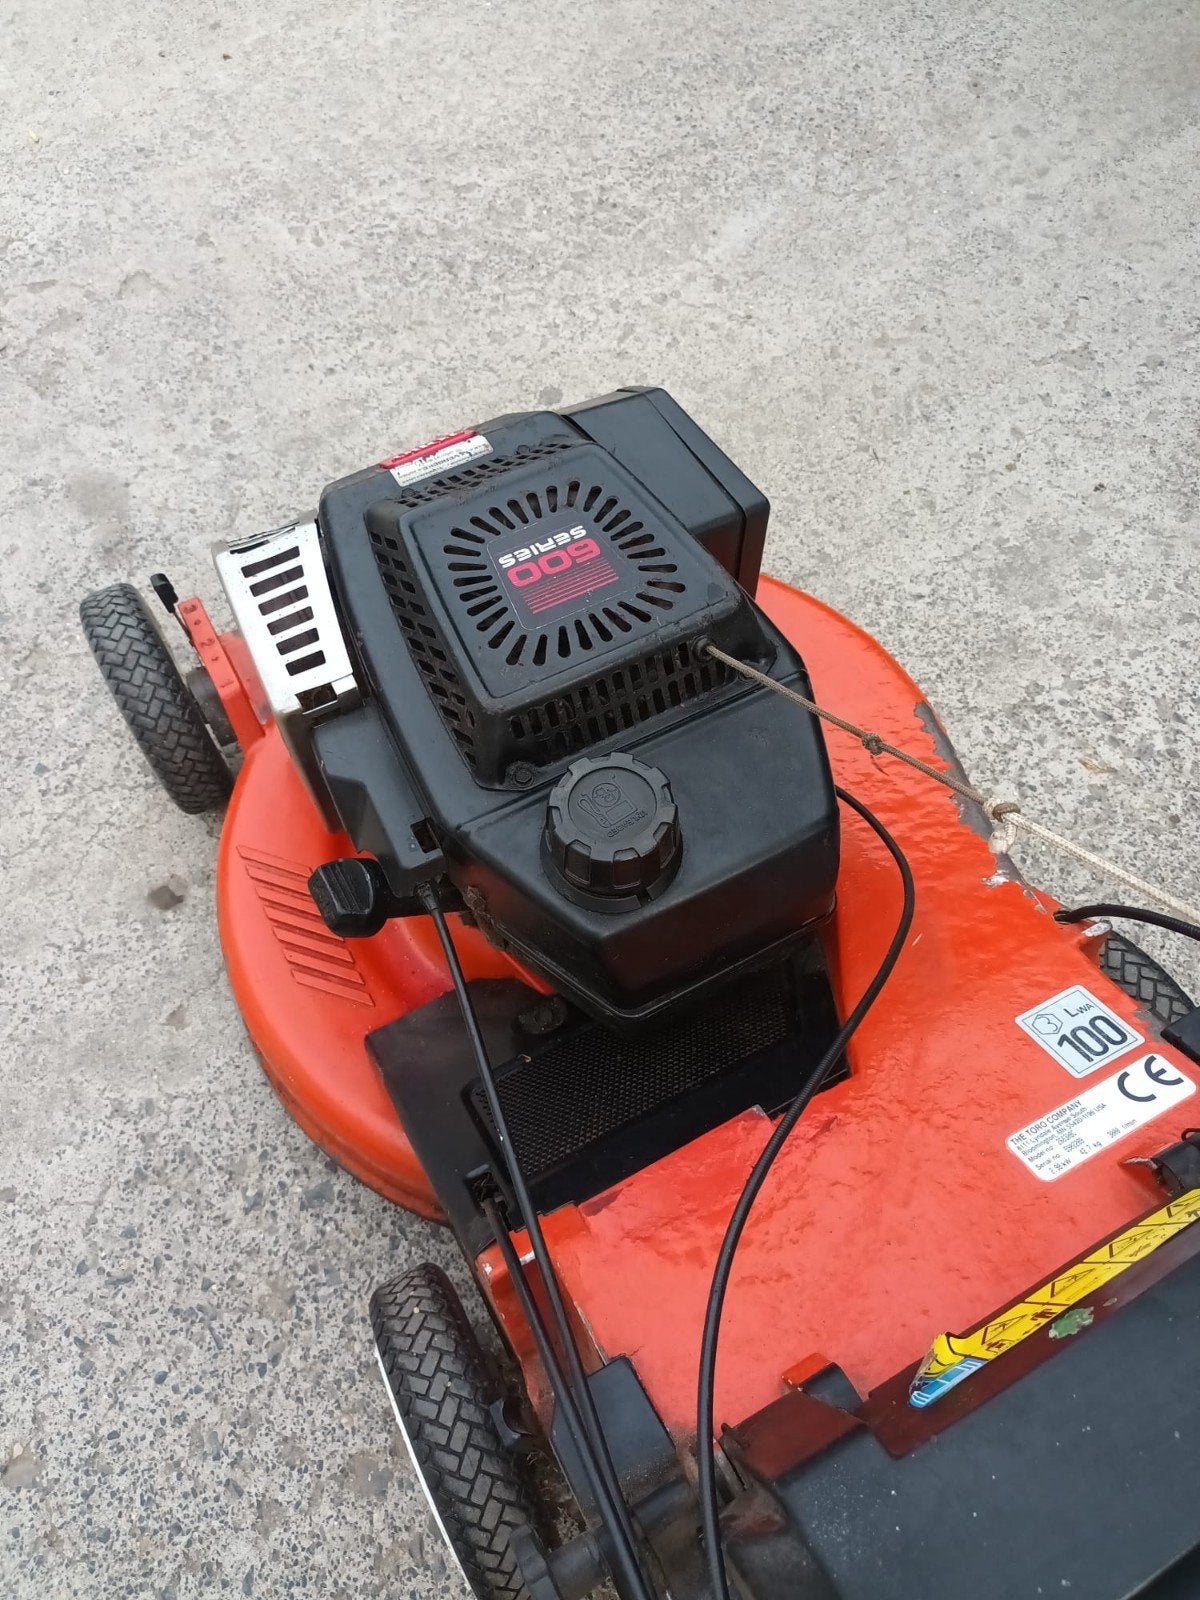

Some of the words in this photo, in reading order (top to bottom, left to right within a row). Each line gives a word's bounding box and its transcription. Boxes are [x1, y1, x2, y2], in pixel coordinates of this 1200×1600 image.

[498, 525, 587, 568] SERIES
[507, 538, 601, 587] 600
[1057, 1015, 1128, 1063] 100
[1117, 1055, 1184, 1102] CE
[1010, 1133, 1027, 1145] THE
[1025, 1121, 1048, 1136] TORO
[1046, 1100, 1082, 1124] COMPANY
